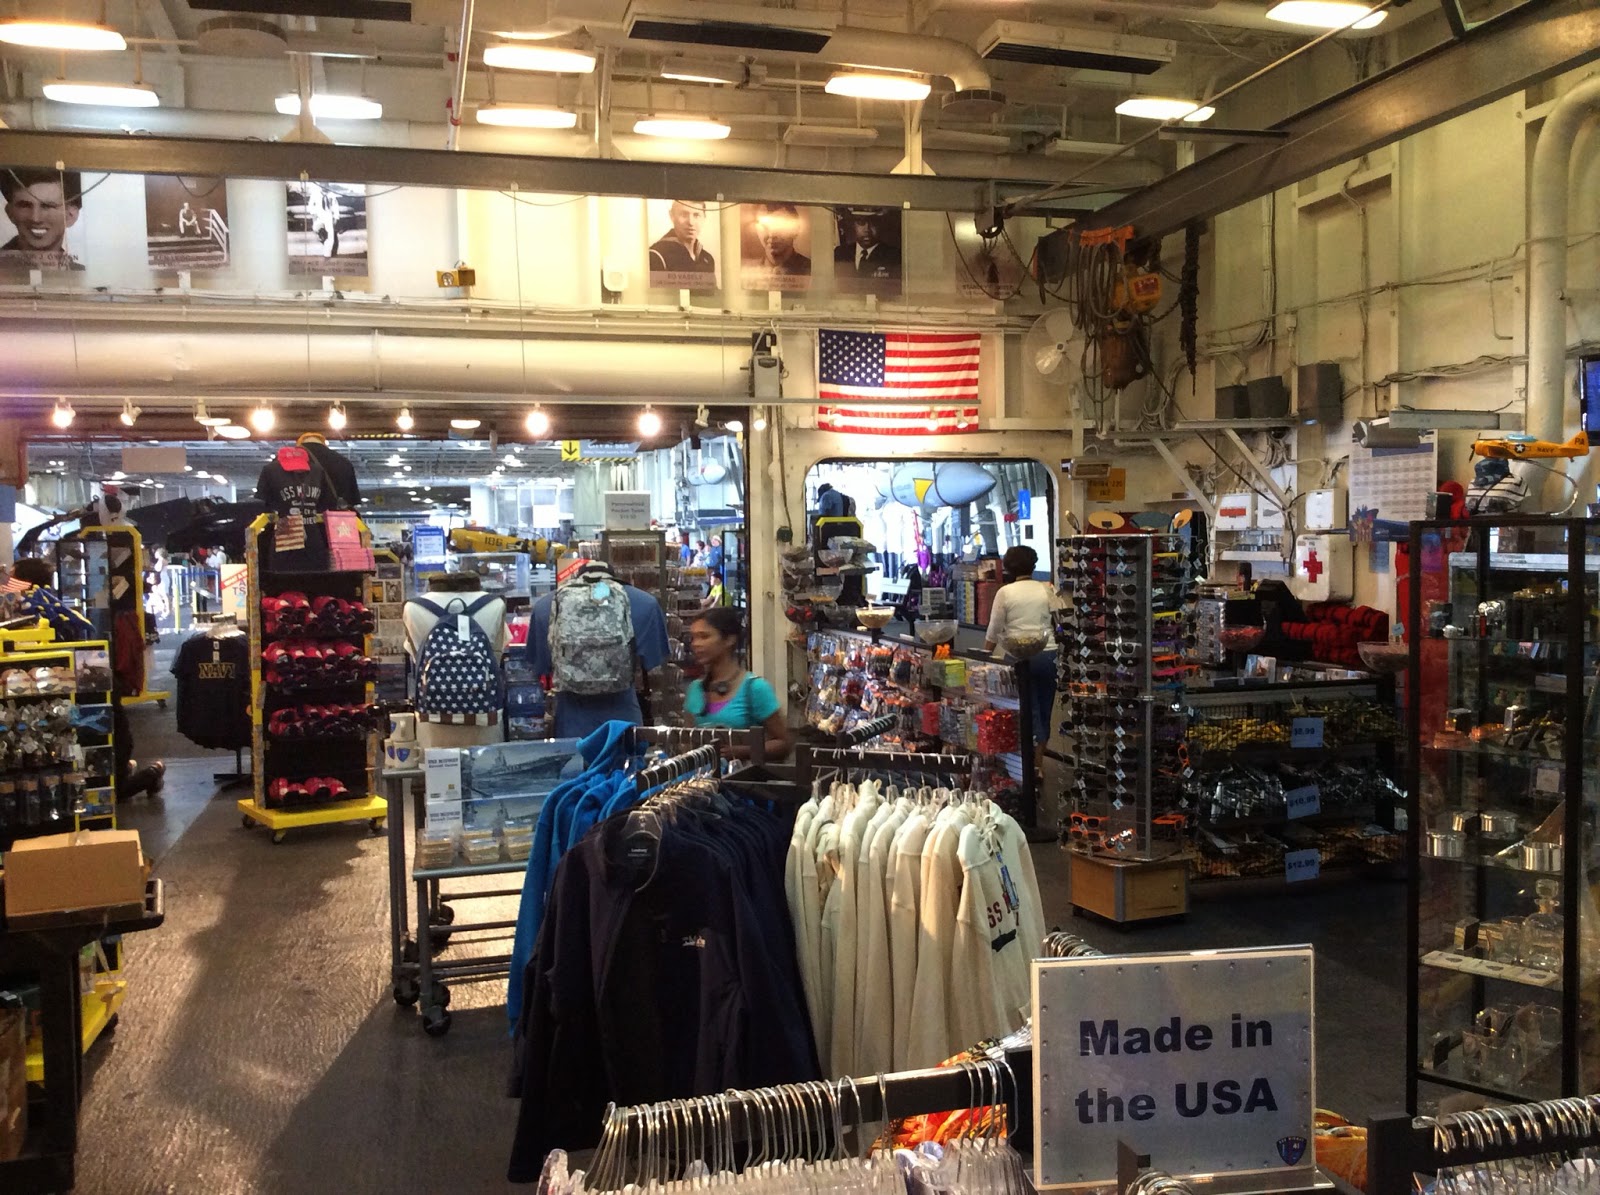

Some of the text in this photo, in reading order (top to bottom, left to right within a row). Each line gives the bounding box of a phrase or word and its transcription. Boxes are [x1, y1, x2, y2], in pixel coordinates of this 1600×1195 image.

[986, 901, 1003, 929] SS
[1079, 1013, 1273, 1056] Made in
[1075, 1077, 1278, 1124] the USA
